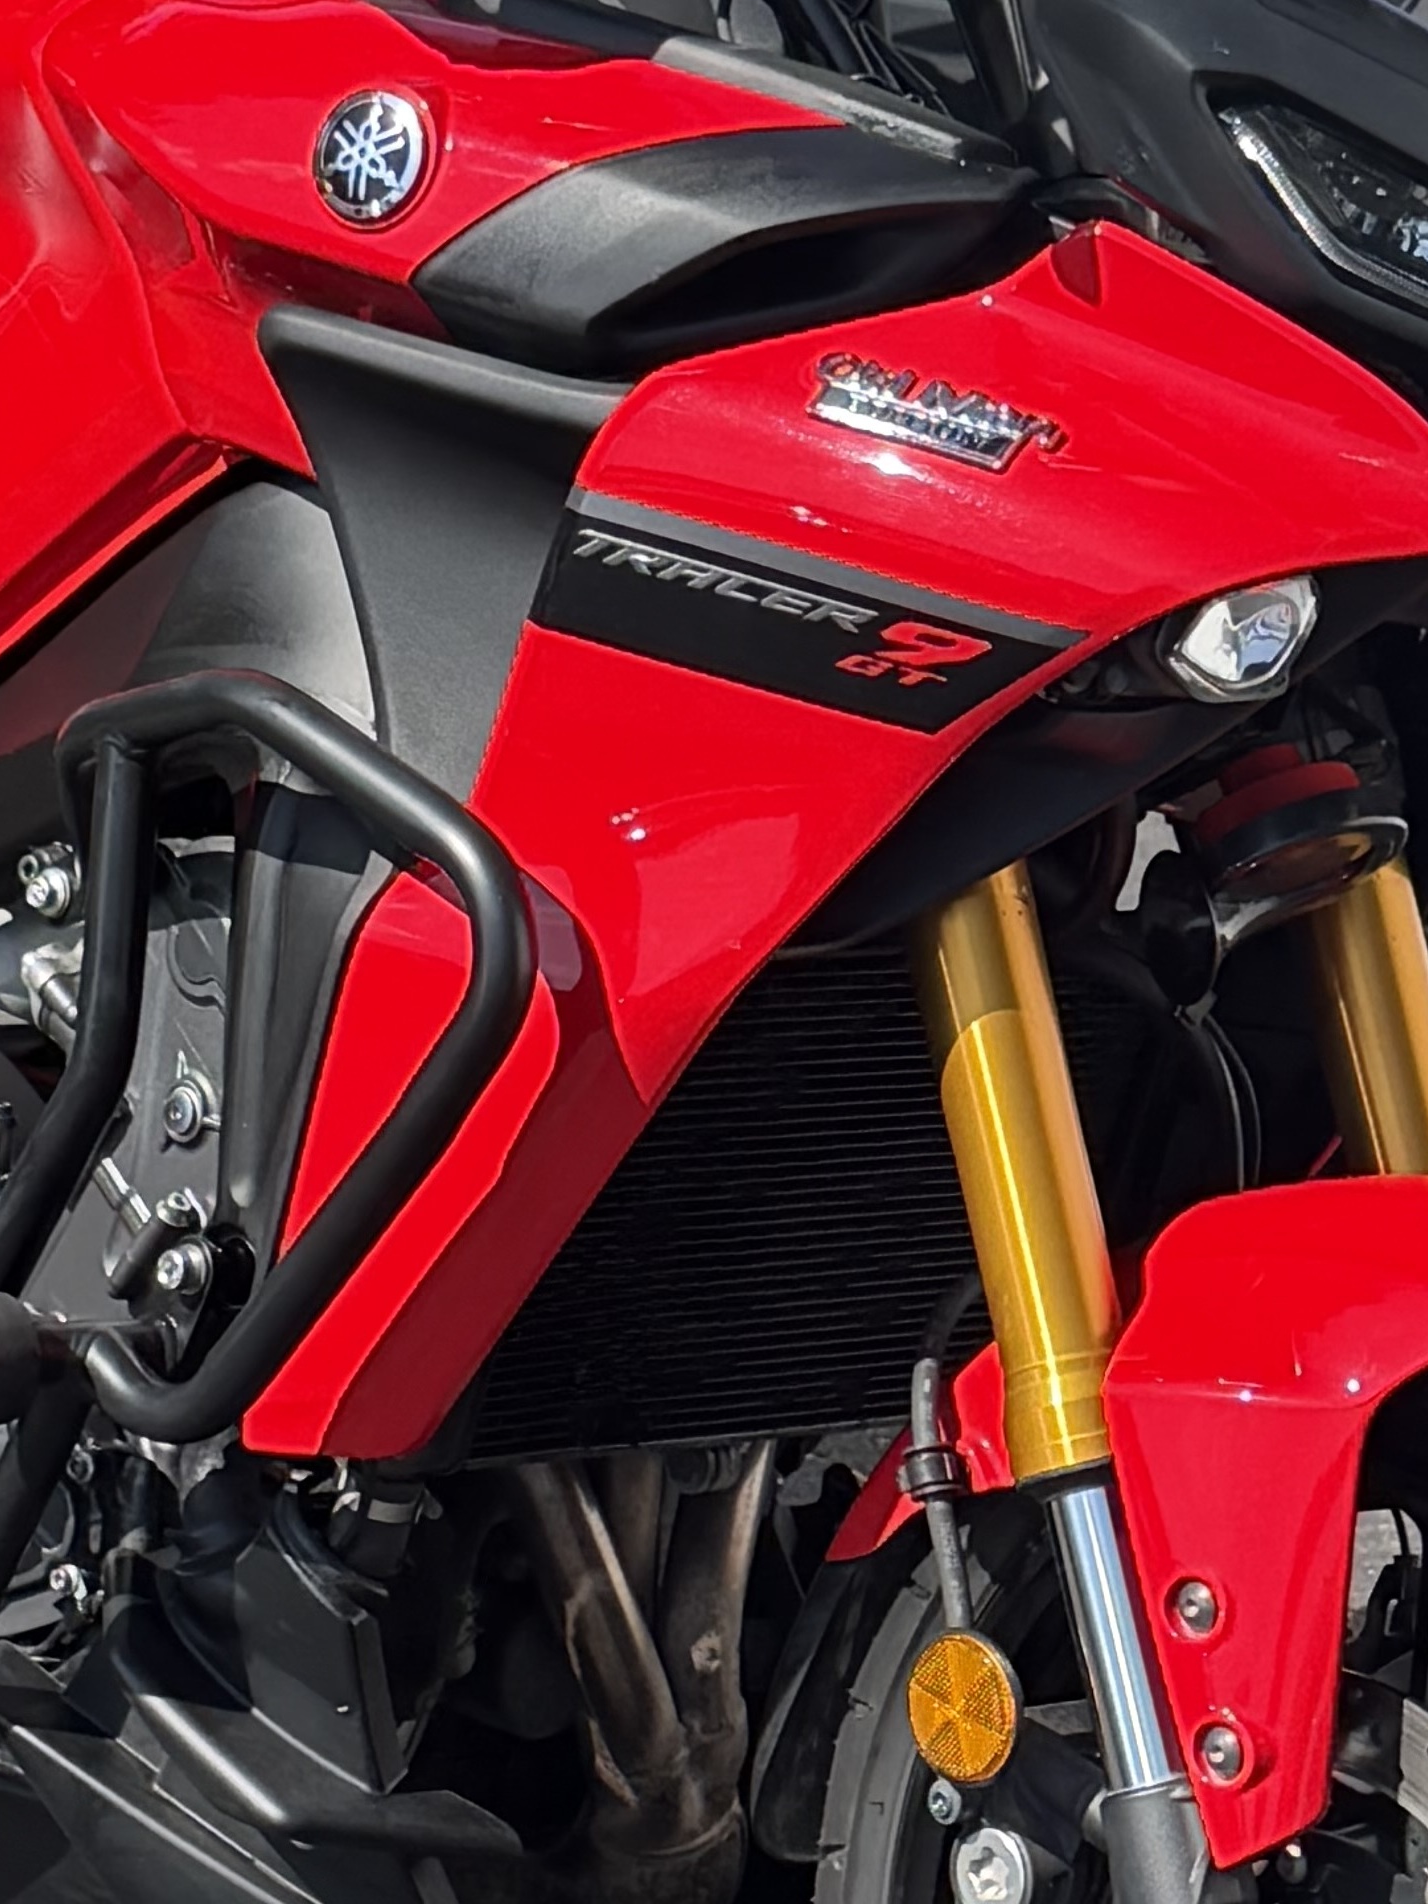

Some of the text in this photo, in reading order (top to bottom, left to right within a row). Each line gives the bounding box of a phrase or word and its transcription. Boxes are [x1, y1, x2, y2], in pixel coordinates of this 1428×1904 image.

[573, 529, 993, 666] TRACER 9
[835, 654, 948, 686] GT
